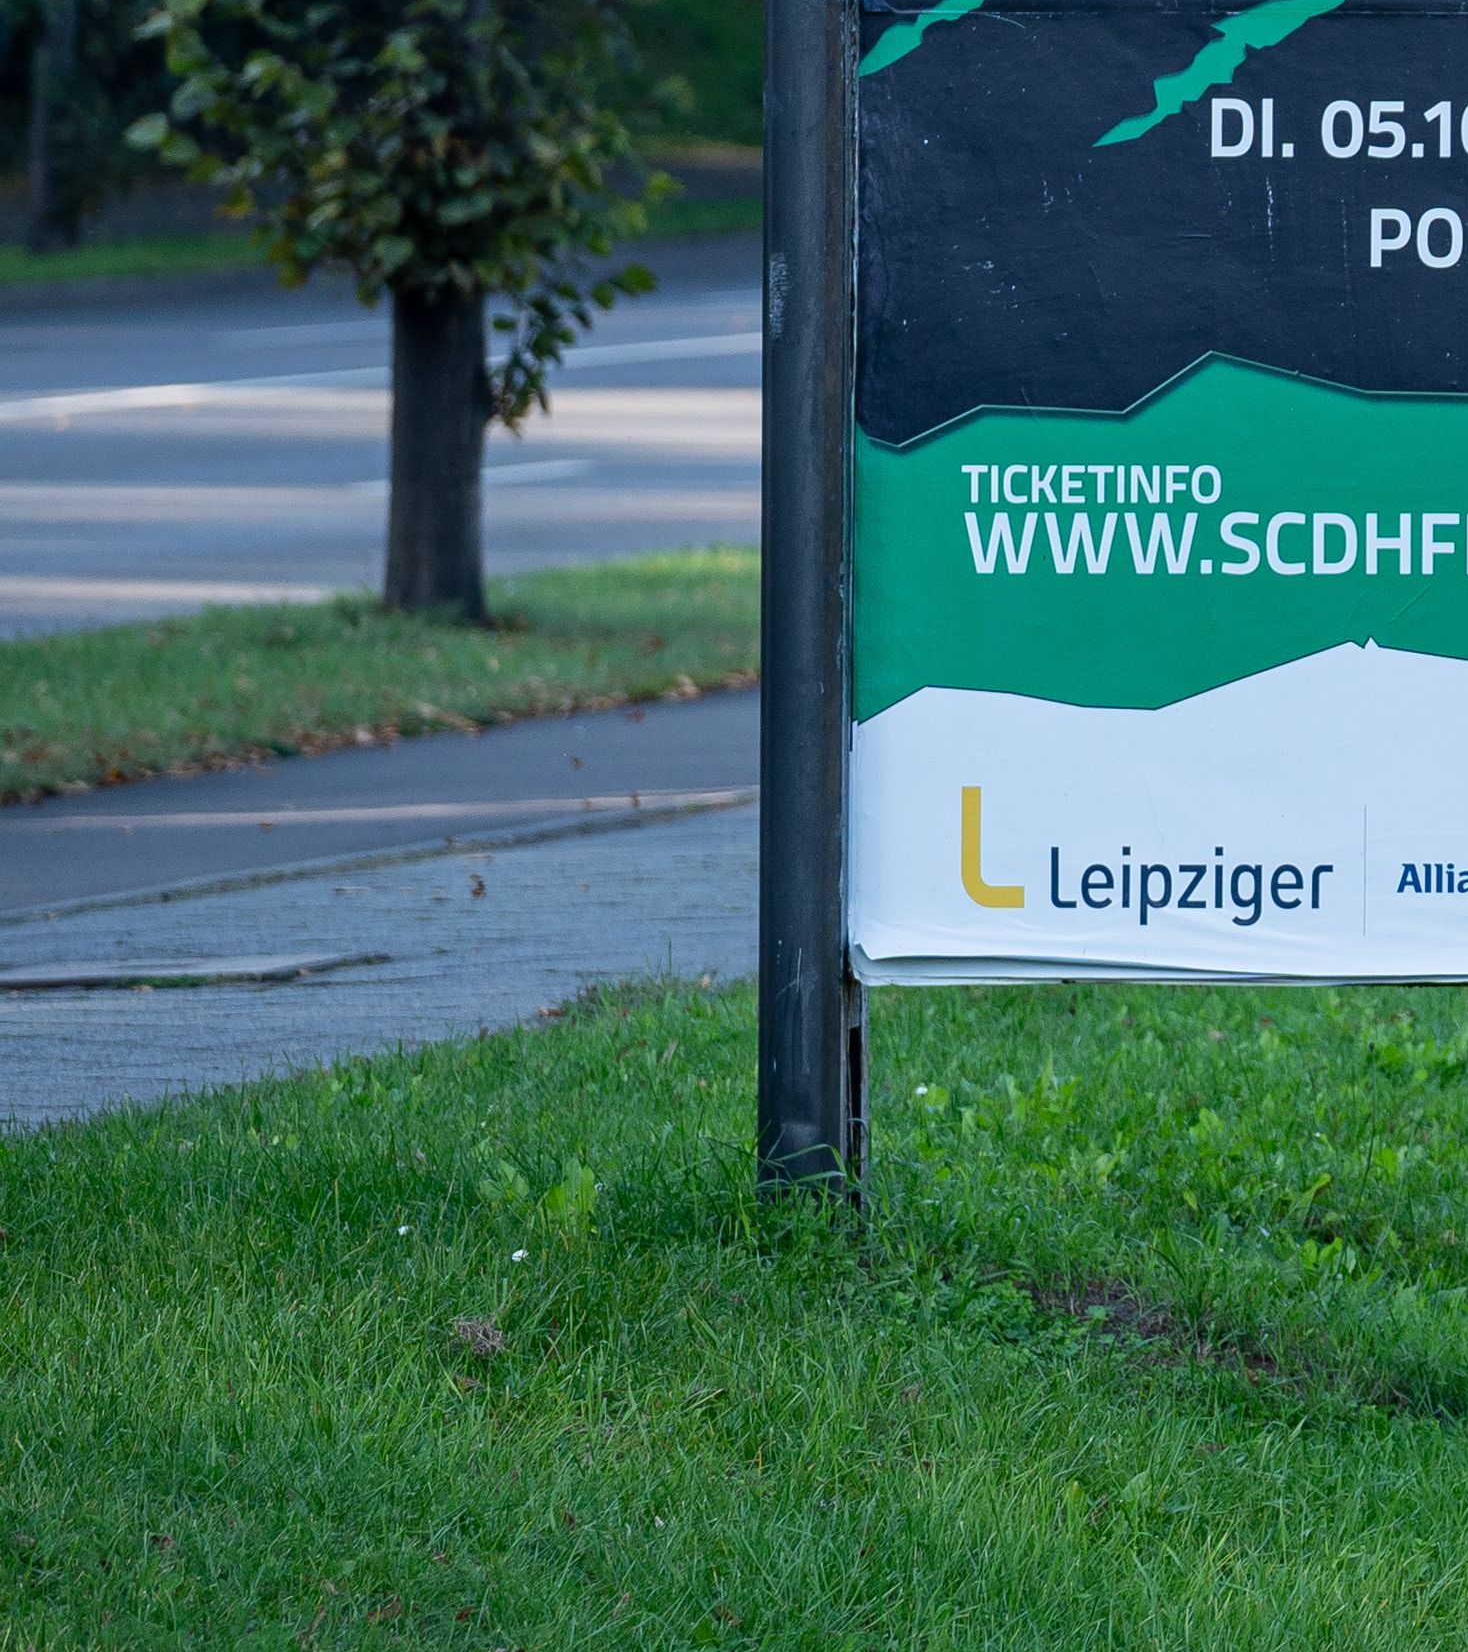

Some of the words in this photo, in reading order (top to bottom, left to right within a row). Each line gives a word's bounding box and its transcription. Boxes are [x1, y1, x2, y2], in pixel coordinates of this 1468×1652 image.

[1211, 98, 1294, 157] DI.
[961, 464, 1221, 504] TICKETINFO
[1051, 847, 1333, 926] Leipziger
